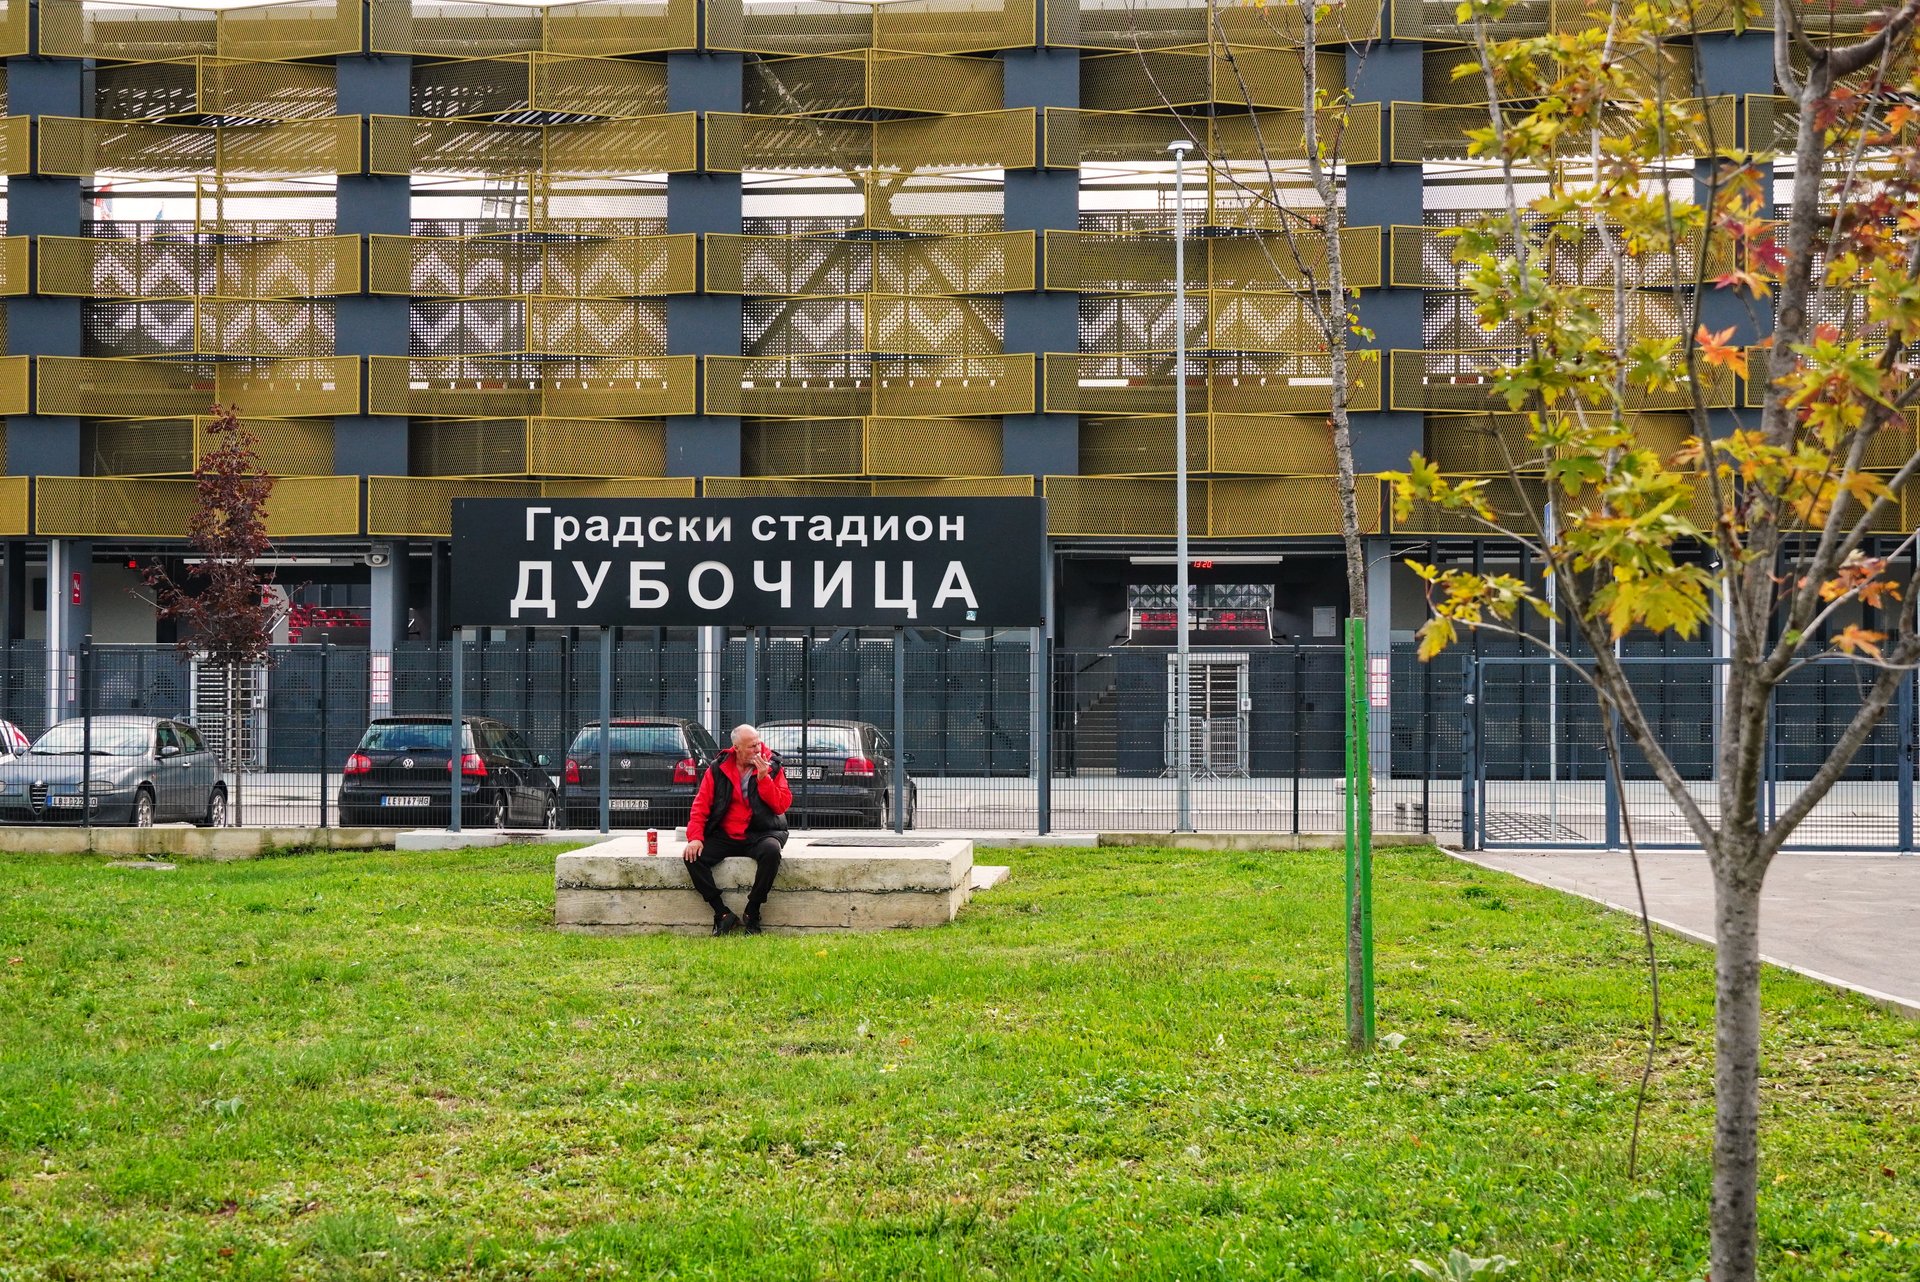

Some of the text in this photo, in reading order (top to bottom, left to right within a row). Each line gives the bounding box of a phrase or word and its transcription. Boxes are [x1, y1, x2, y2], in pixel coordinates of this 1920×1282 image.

[526, 507, 965, 550] Градски стадион
[510, 560, 979, 619] ДУБОЧИЦА
